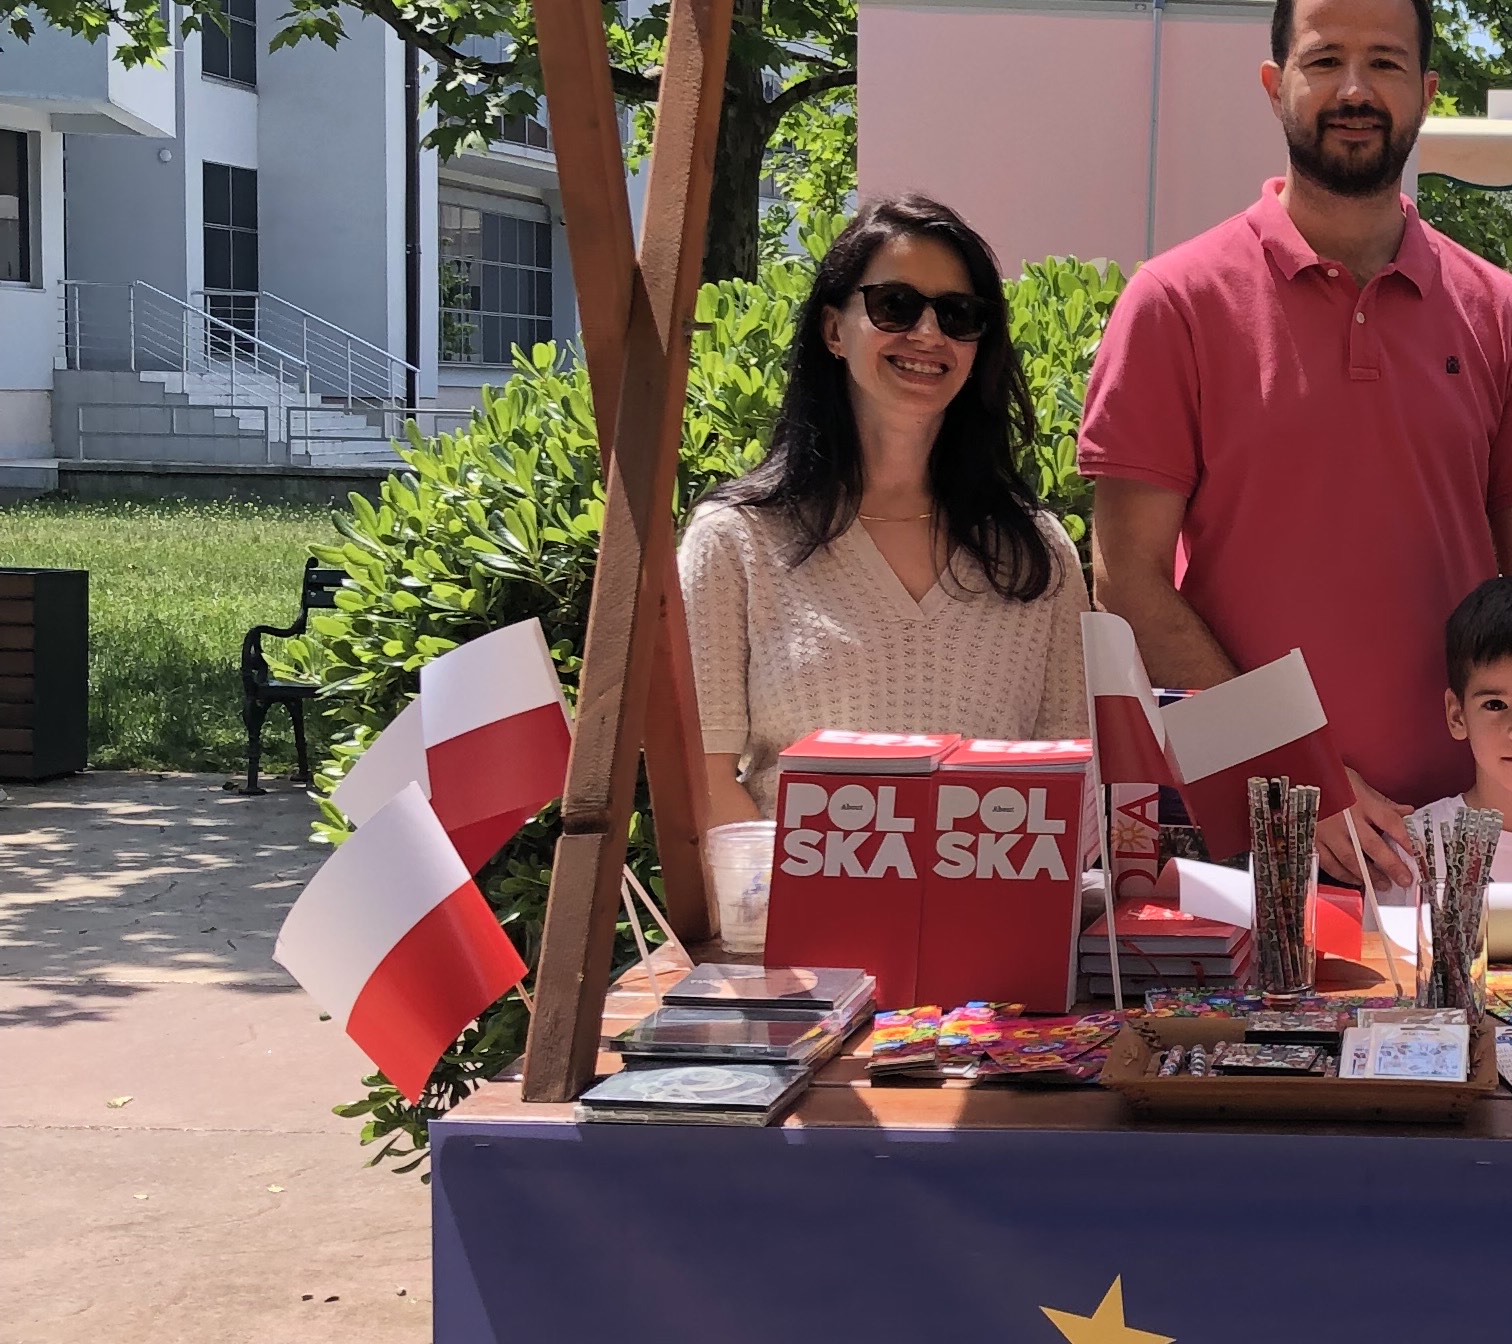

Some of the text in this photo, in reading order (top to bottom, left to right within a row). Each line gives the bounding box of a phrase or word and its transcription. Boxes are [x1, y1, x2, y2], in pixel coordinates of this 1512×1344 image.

[784, 783, 915, 832] POL
[936, 785, 1066, 834] POL
[780, 829, 917, 879] SKA
[932, 831, 1069, 881] SKA
